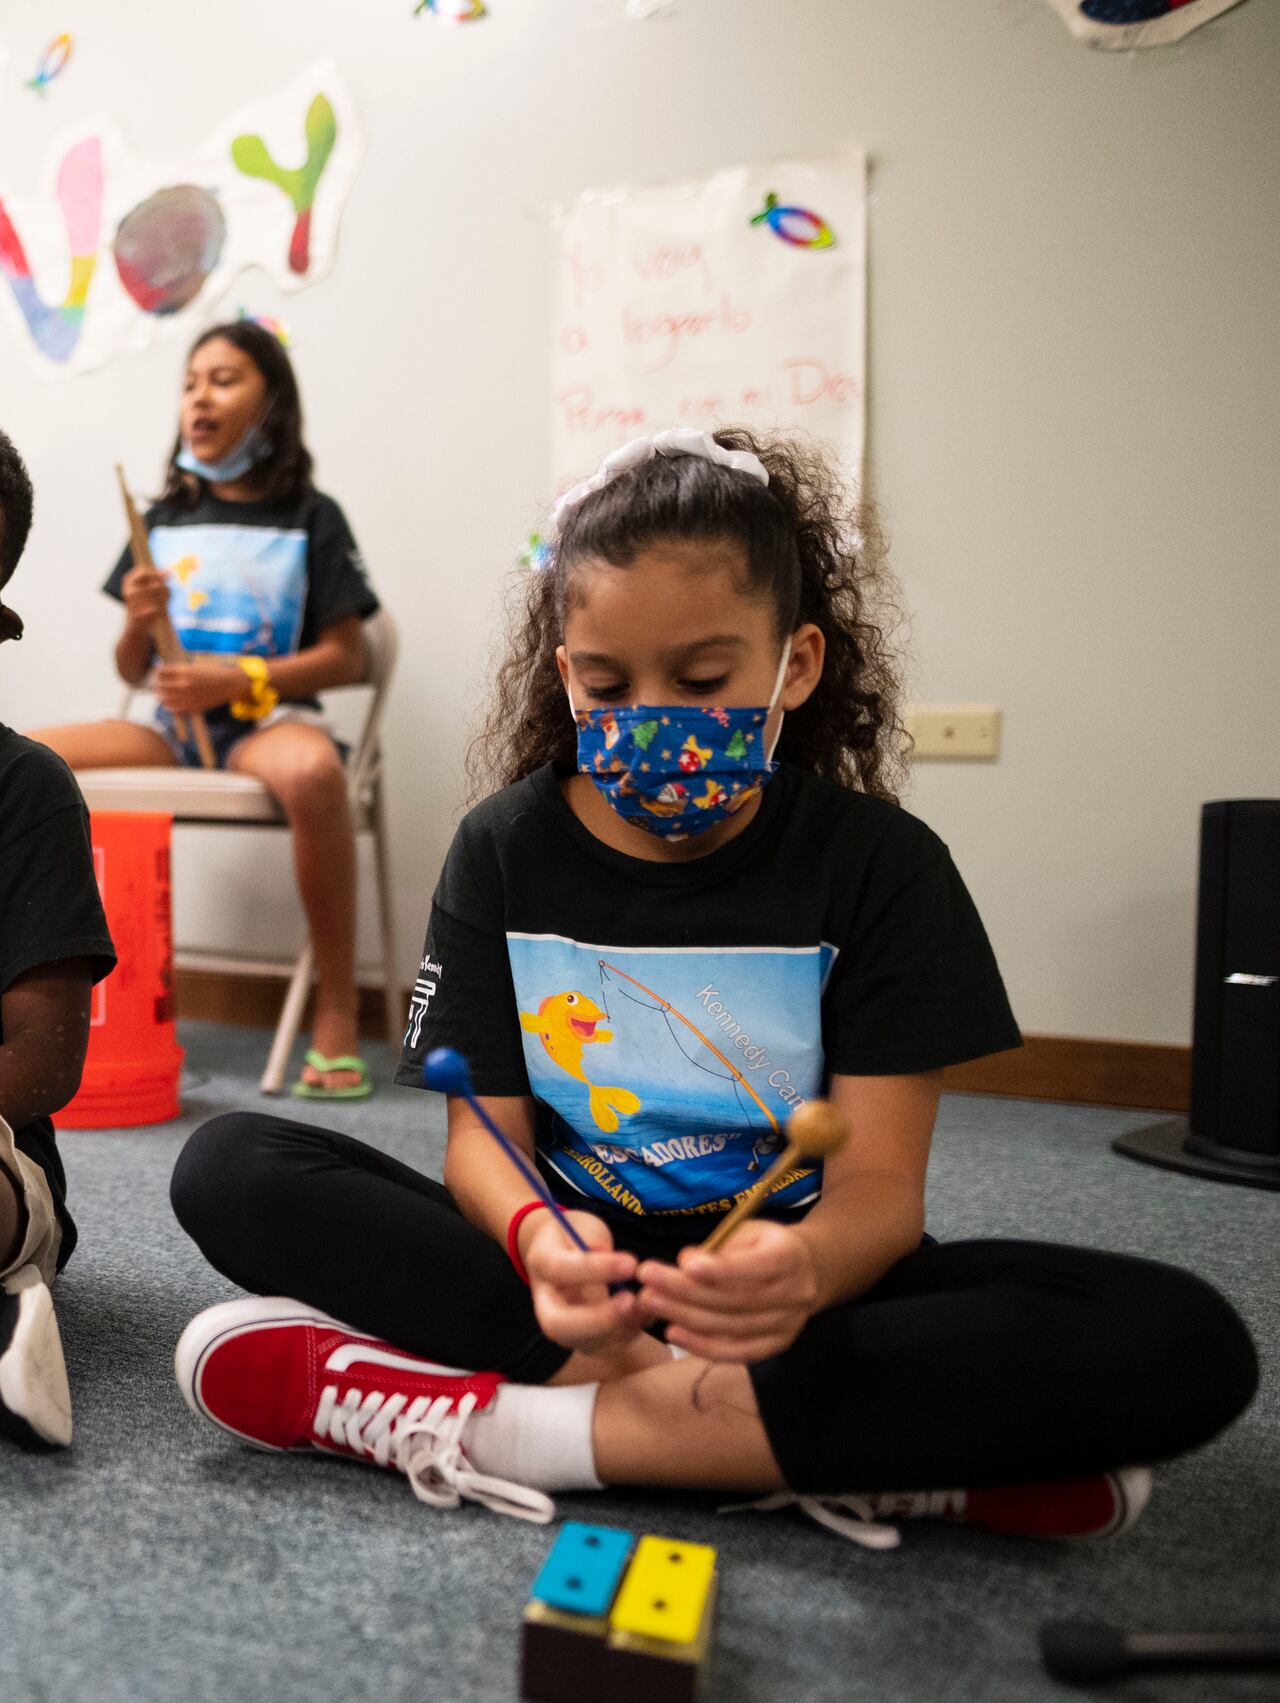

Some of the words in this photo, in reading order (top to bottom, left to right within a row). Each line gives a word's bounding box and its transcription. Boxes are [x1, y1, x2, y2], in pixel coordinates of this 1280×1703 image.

[696, 983, 772, 1071] Kennedy
[767, 1068, 808, 1112] Cam
[589, 1133, 743, 1168] ESCADORES”
